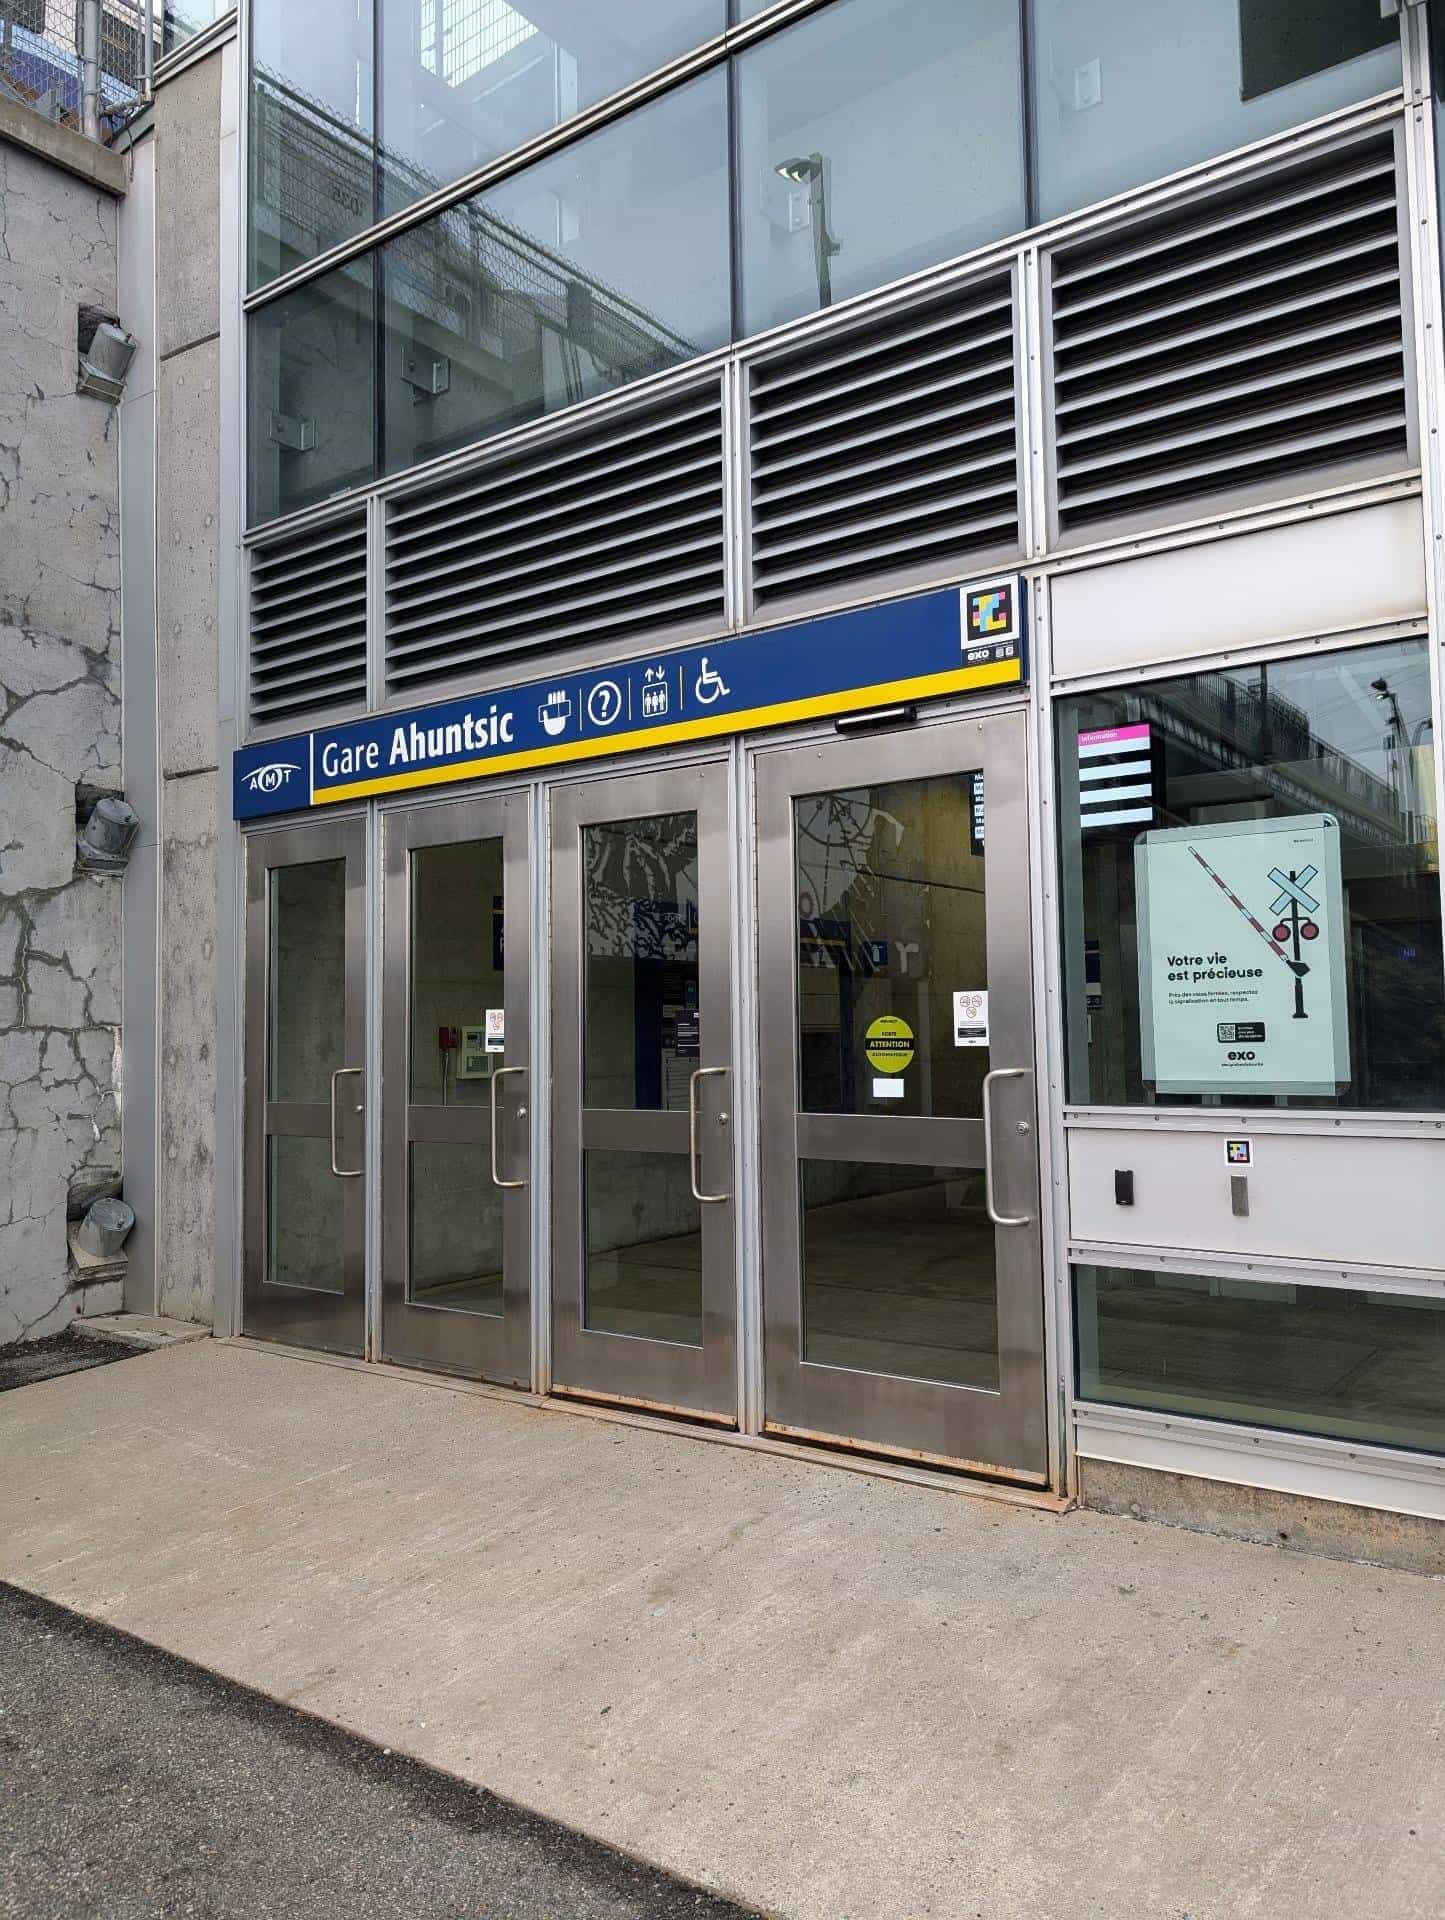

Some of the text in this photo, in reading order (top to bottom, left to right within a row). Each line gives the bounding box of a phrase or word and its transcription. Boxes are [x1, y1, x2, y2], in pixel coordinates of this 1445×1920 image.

[967, 649, 990, 661] exo
[322, 705, 514, 777] Gare Ahuntsic
[1081, 731, 1118, 744] Information
[249, 768, 292, 792] AMT
[1167, 952, 1227, 967] Votre vie
[1167, 967, 1263, 984] est précieuse
[870, 1040, 910, 1049] ATTENTION
[1227, 1051, 1255, 1061] exo
